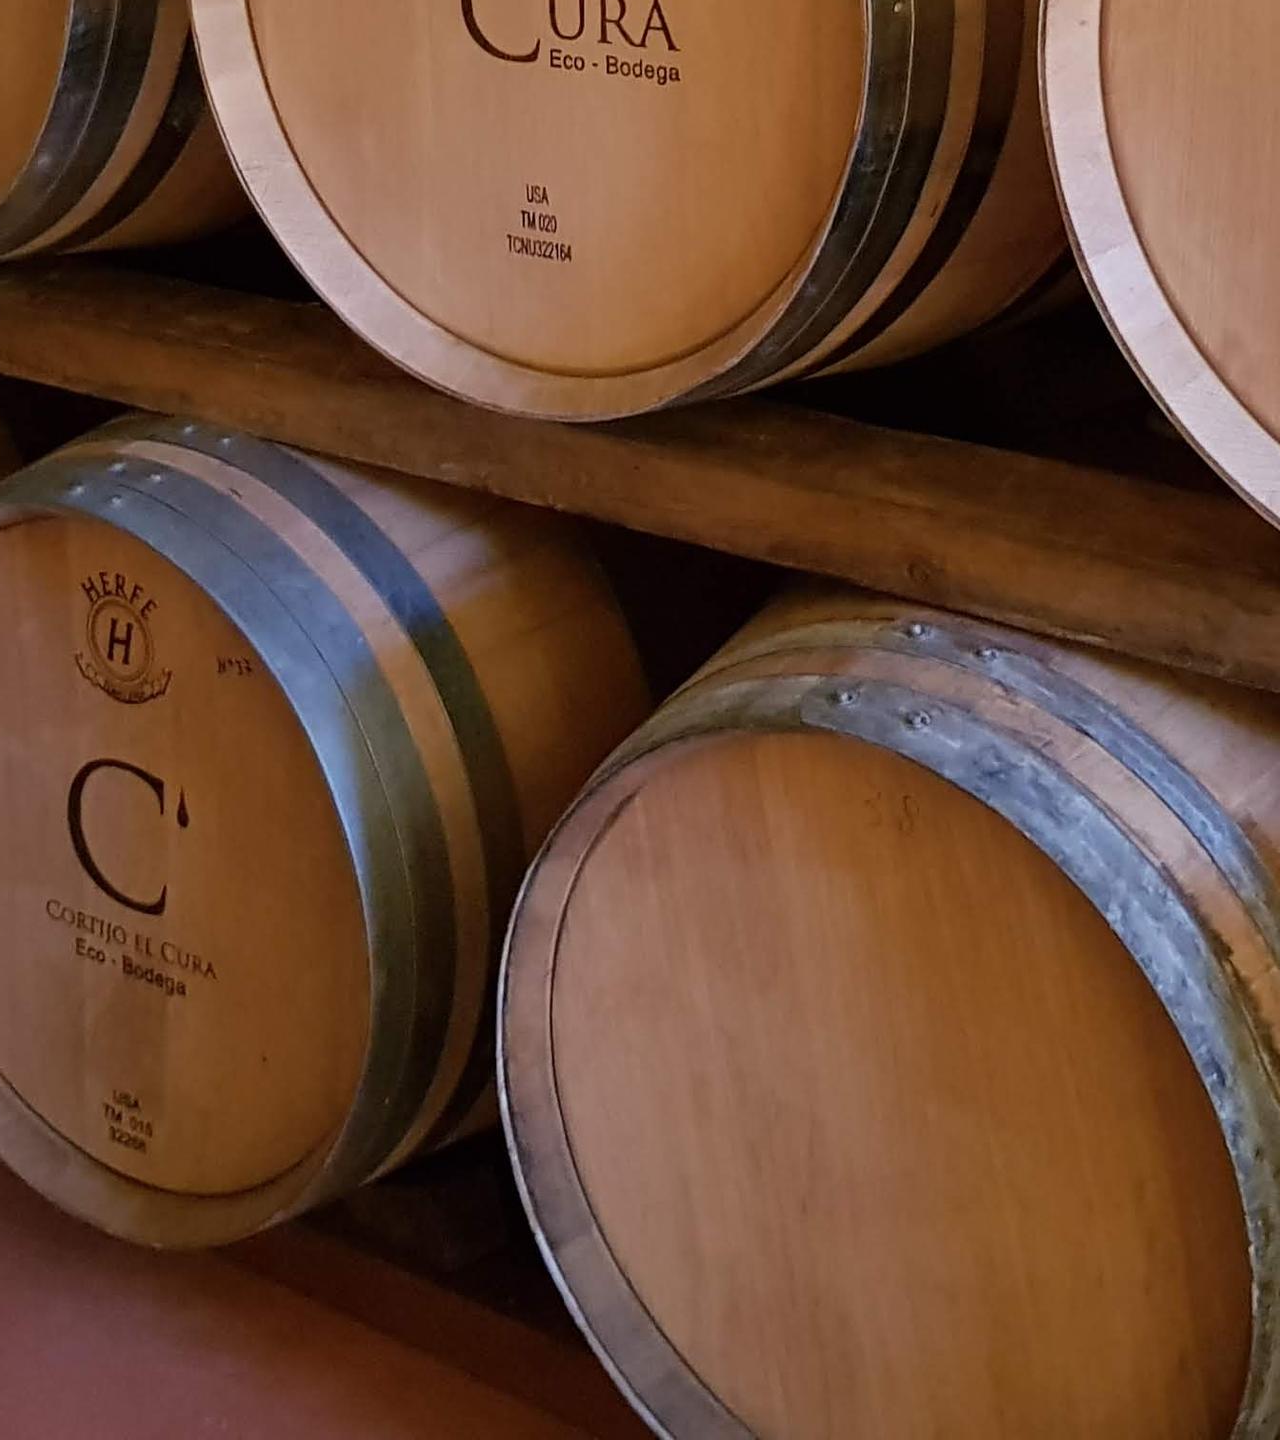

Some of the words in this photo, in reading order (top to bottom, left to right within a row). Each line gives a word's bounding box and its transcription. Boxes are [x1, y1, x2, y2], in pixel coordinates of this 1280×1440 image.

[549, 48, 586, 71] Eco
[606, 54, 681, 85] Bodega
[526, 184, 549, 206] USA
[521, 209, 537, 230] TM
[538, 213, 558, 234] 020
[80, 571, 158, 620] HERFE
[106, 617, 134, 665] H
[45, 899, 128, 945] CORTIJO
[135, 933, 153, 958] EL
[160, 941, 219, 981] CURA
[75, 937, 106, 963] Eco
[122, 954, 187, 997] Bodega
